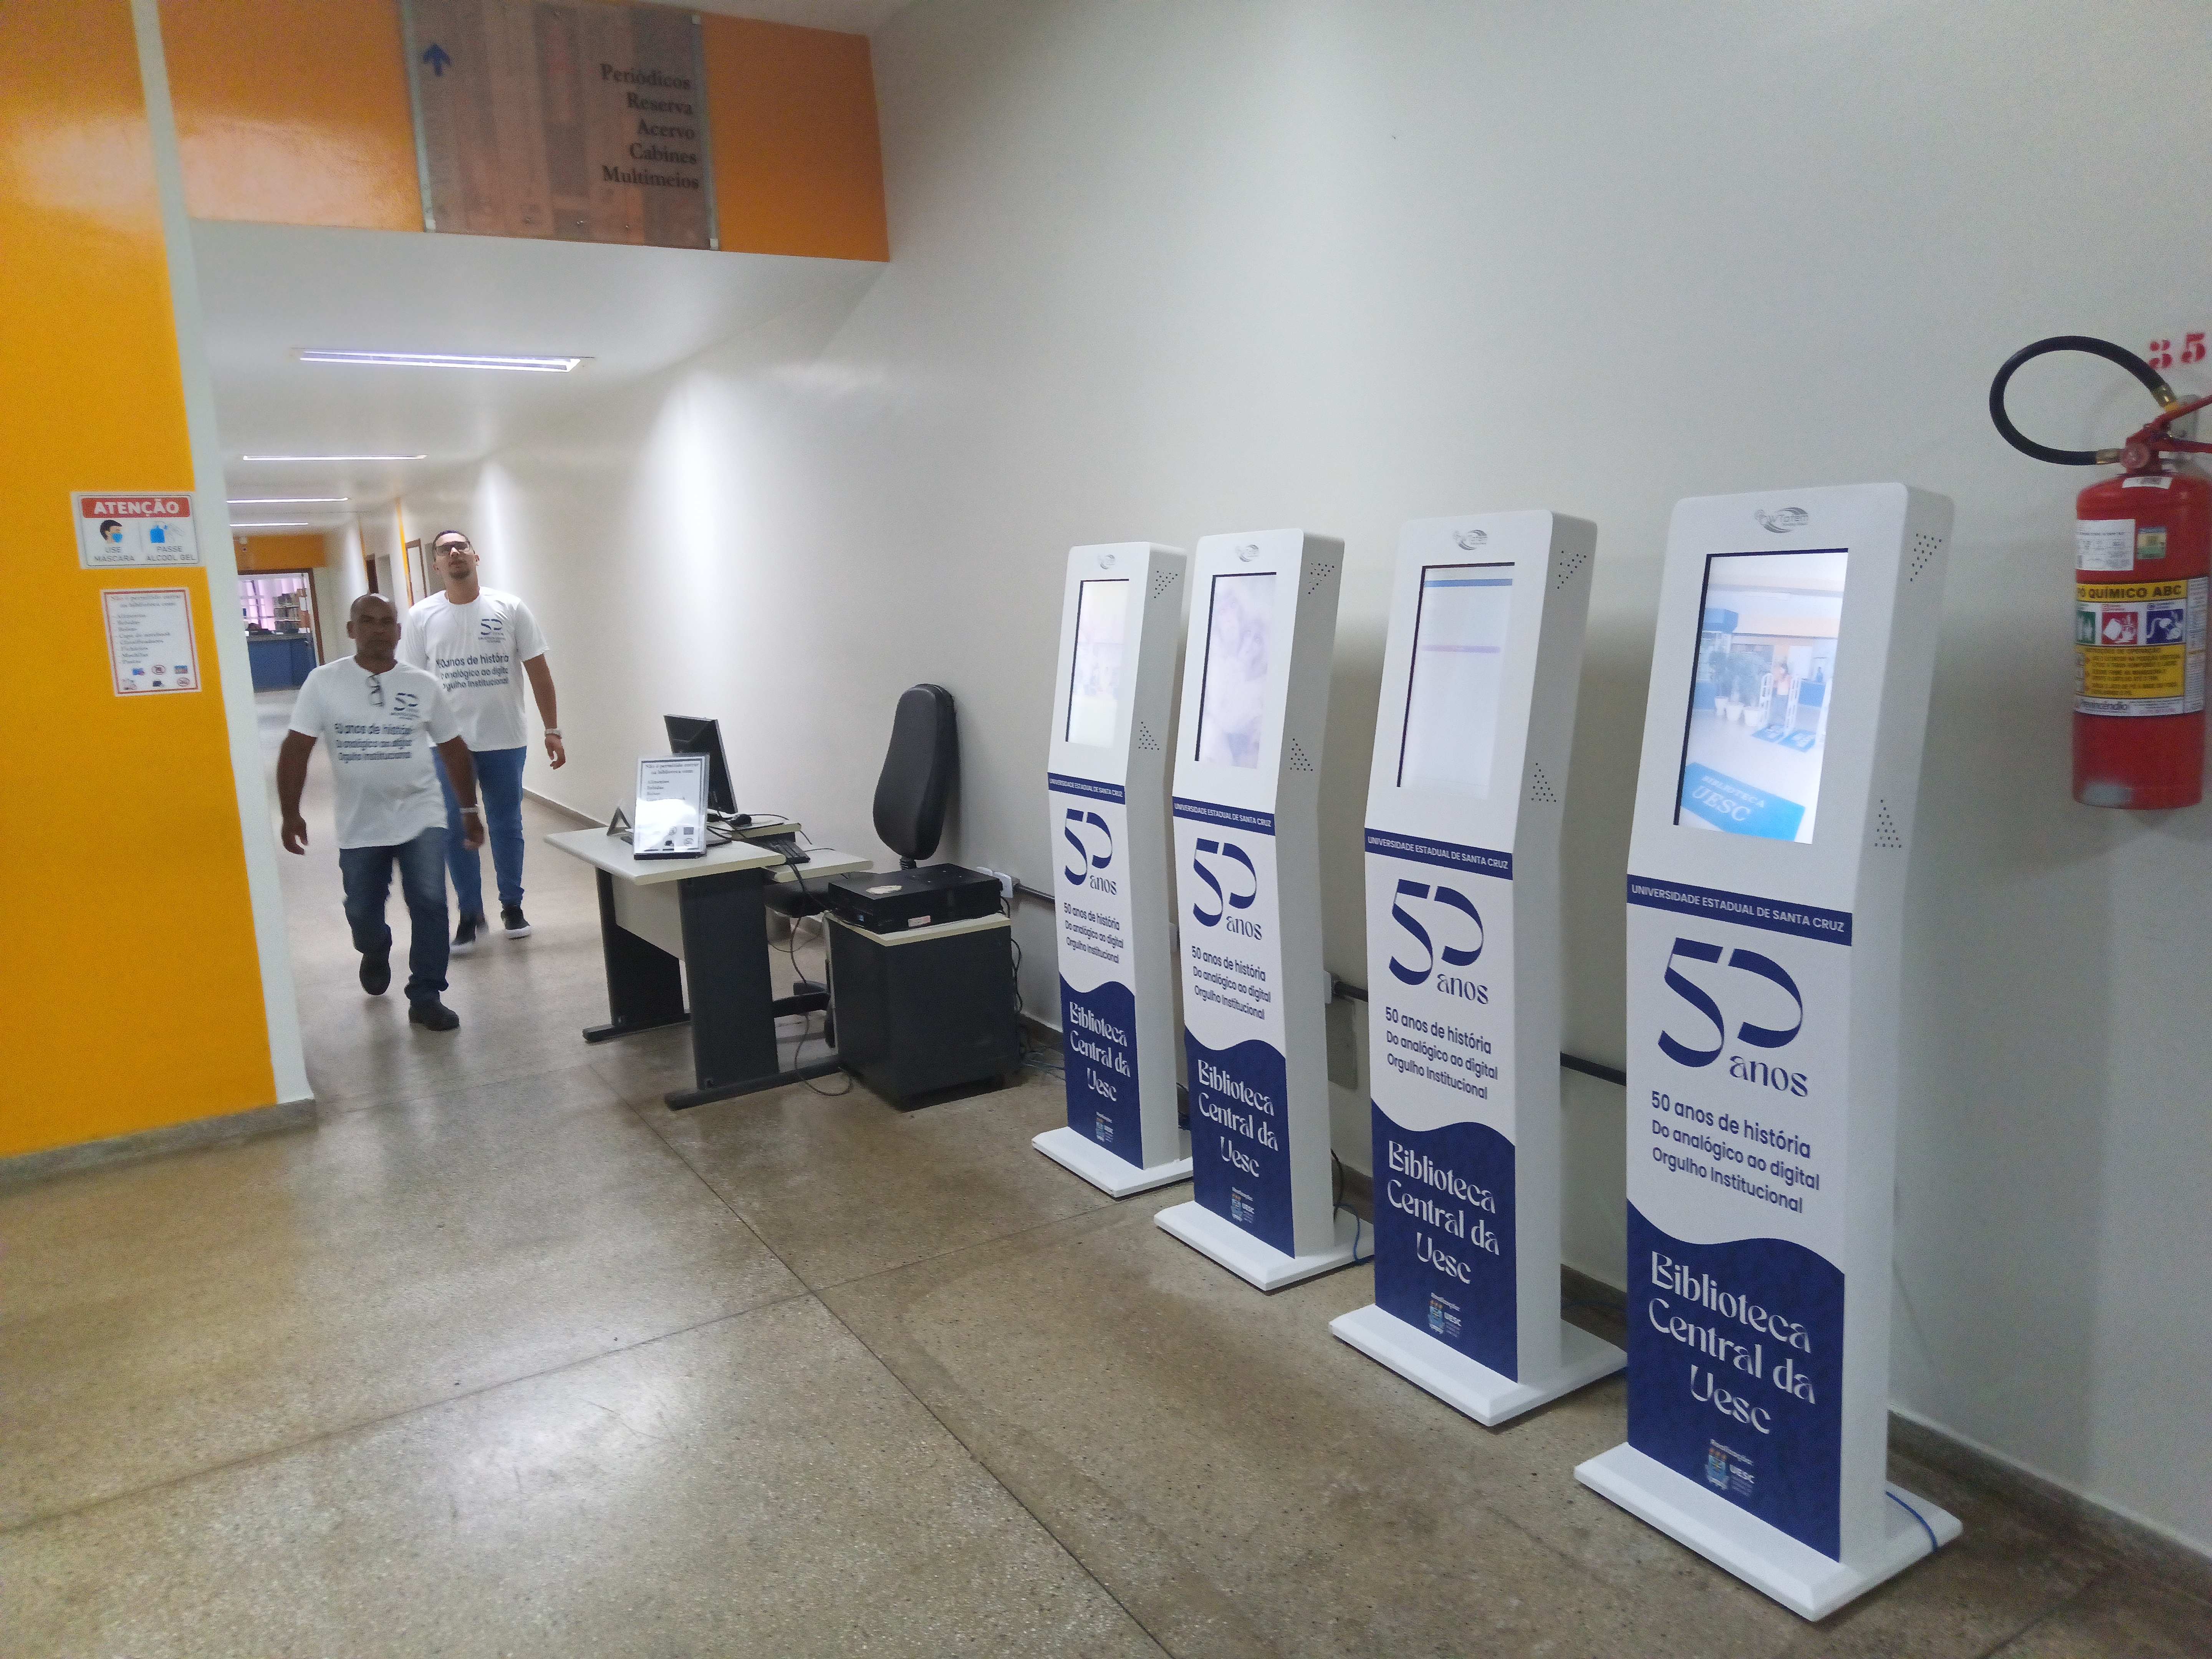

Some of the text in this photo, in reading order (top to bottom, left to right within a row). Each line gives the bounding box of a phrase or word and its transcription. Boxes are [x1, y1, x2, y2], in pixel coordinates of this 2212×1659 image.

[600, 63, 691, 90] Periódicos
[626, 91, 693, 115] Reserva
[637, 118, 694, 140] Acervo
[629, 142, 697, 165] Cabines
[602, 165, 699, 189] Multimeios
[94, 498, 180, 517] ATENÇÃO
[2088, 585, 2147, 598] QUÍMICO
[2152, 584, 2181, 597] ABC
[467, 655, 478, 665] de
[1239, 815, 1257, 824] SANTA
[1257, 818, 1272, 827] CRUZ
[1692, 786, 1751, 821] UESC
[1065, 808, 1113, 886] 50
[1368, 836, 1508, 869] UNIVERSIDADE ESTADUAL DE SANTA CRUZ
[1089, 875, 1117, 895] anos
[1193, 838, 1257, 927] 50
[1226, 916, 1262, 940] anos
[1631, 884, 1844, 932] UNIVERSIDADE ESTADUAL DE SANTA CRUZ
[1389, 879, 1484, 985] 50
[1192, 945, 1266, 982] 50 anos de história
[1193, 966, 1271, 1003] Do analógico ao digital
[1195, 985, 1265, 1020] Orgulho Institucional
[1437, 973, 1489, 1005] anos
[1657, 937, 1803, 1068] 50
[1070, 1001, 1128, 1047] Biblioteca
[1386, 1006, 1492, 1055] 50 anos de história
[1070, 1030, 1131, 1078] Central da
[1386, 1030, 1498, 1080] Do analógico ao digital
[1387, 1053, 1487, 1100] Orgulho Institucional
[1729, 1055, 1809, 1097] anos
[1087, 1067, 1117, 1102] Uesc
[1198, 1059, 1274, 1116] Biblioteca
[1199, 1092, 1279, 1151] Central da
[1651, 1091, 1811, 1159] 50 anos de história
[1220, 1136, 1260, 1177] Uesc
[1389, 1140, 1495, 1214] Biblioteca
[1652, 1120, 1820, 1190] Do analógico ao digital
[1652, 1147, 1803, 1213] Orgulho Institucional
[1387, 1179, 1500, 1255] Central da
[1416, 1232, 1471, 1284] Uesc
[1652, 1250, 1811, 1353] Biblioteca
[1649, 1298, 1816, 1404] Central da
[1691, 1364, 1771, 1434] Uesc
